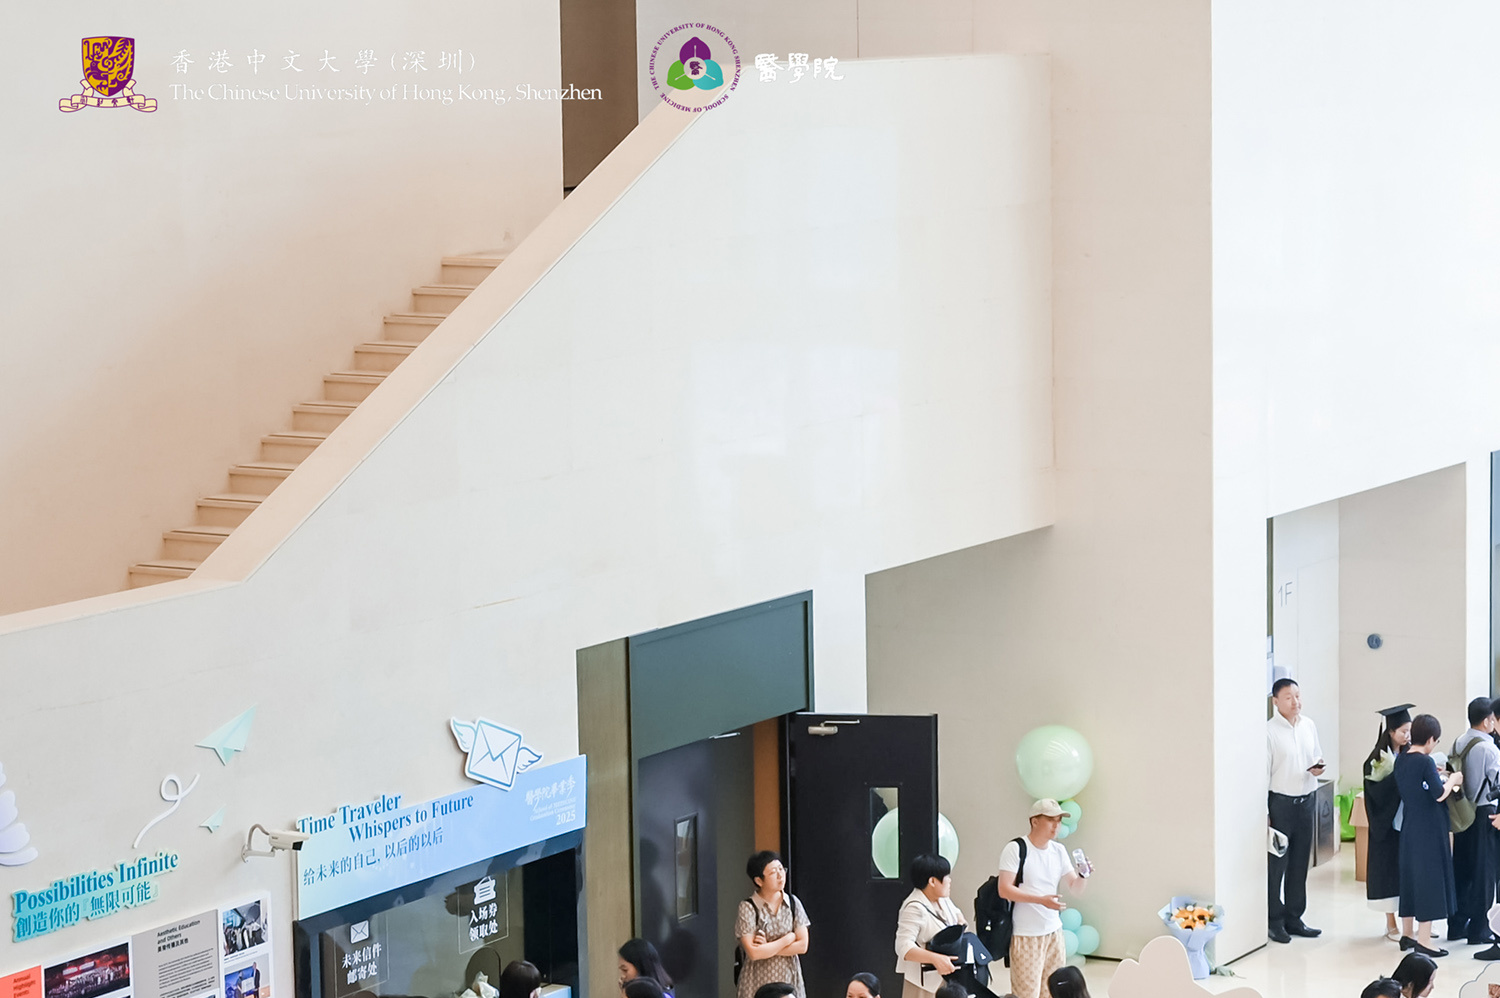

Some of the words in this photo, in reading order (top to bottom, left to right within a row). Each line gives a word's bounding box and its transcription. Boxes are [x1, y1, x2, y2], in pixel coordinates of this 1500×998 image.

[298, 813, 335, 835] Time
[339, 795, 401, 825] Traveler
[349, 813, 412, 843] Whispers
[415, 808, 428, 824] to
[432, 795, 474, 819] Future
[556, 810, 576, 826] 2025
[15, 870, 114, 914] Possibilities
[119, 852, 179, 883] Infinite
[342, 942, 382, 969] 未来信件
